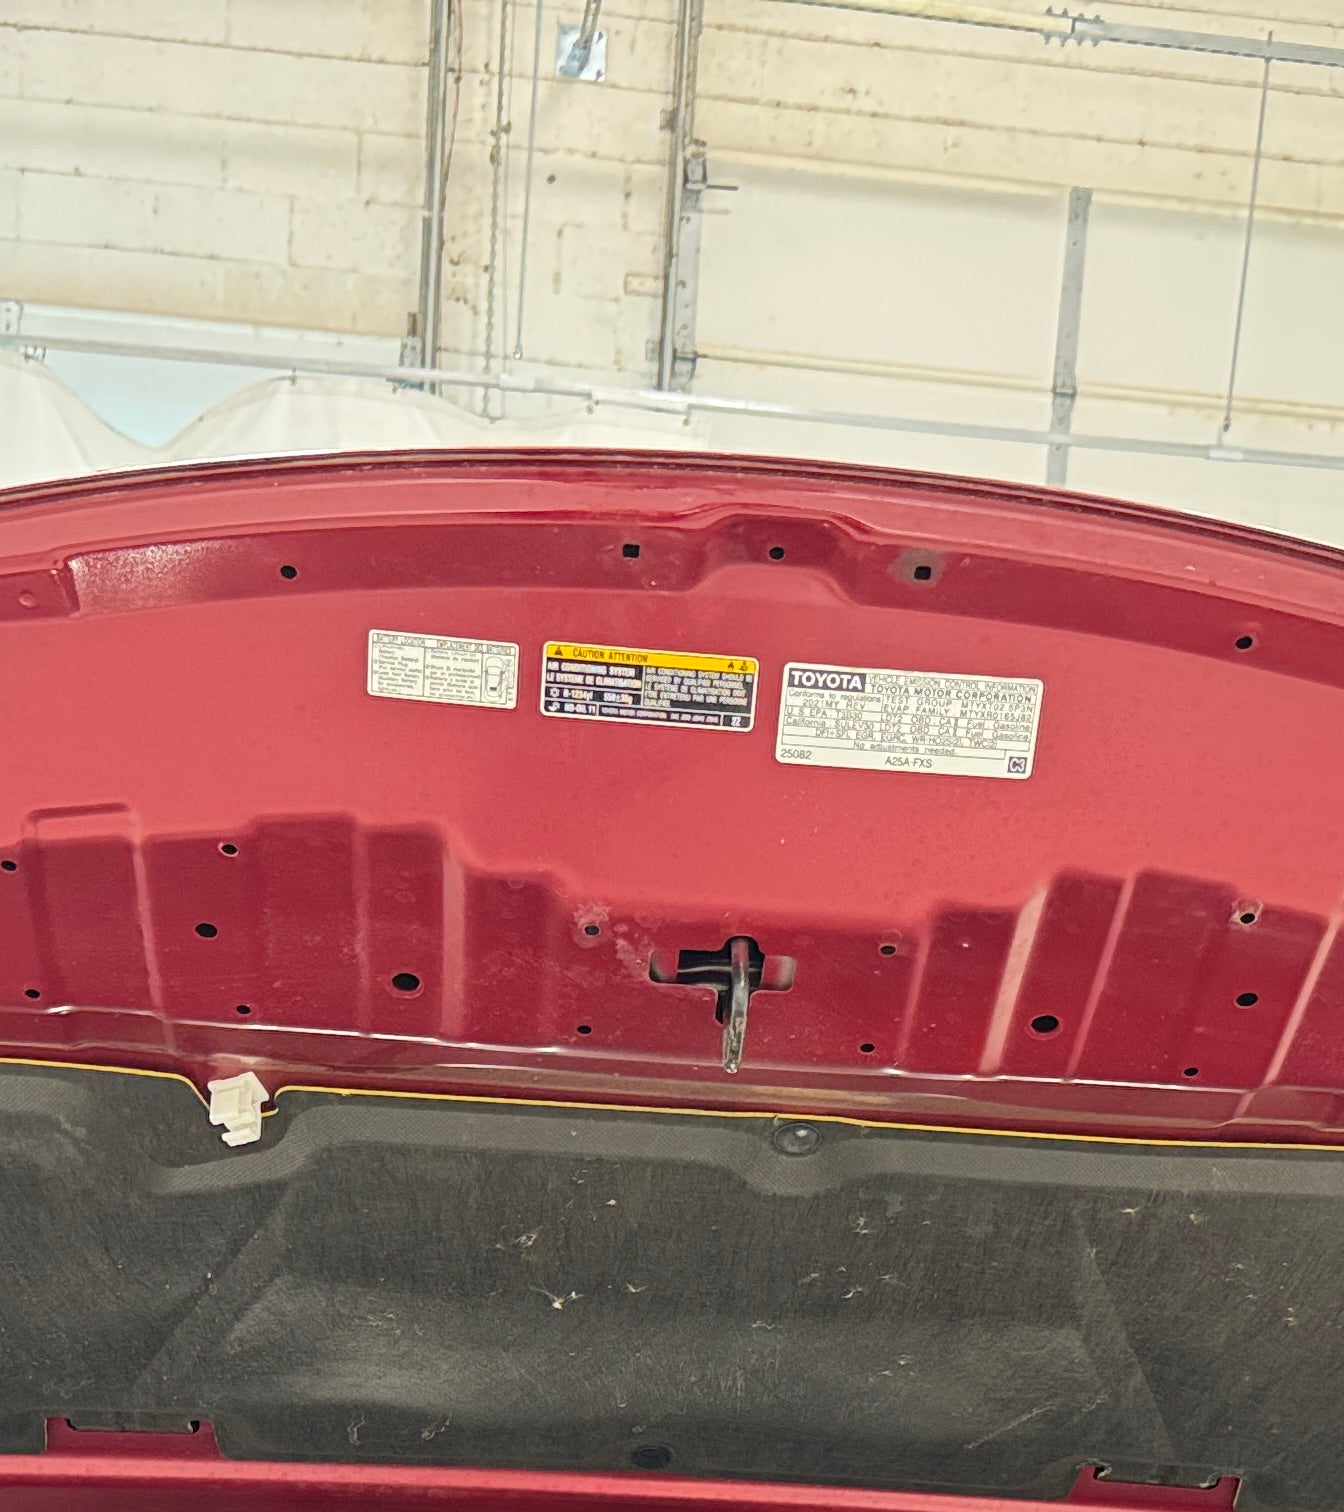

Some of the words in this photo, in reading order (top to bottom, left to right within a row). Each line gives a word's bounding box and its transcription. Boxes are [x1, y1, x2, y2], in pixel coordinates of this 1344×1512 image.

[572, 647, 604, 659] CAUTION
[608, 651, 648, 663] ATTENTION
[790, 670, 863, 690] TOYOTA
[944, 680, 977, 690] CONTROL
[870, 684, 910, 695] TOYOTA
[913, 687, 951, 698] MOTOR
[955, 690, 1031, 703] CORPORATION
[885, 695, 909, 704] TEST
[802, 698, 839, 709] 2021MY
[883, 704, 909, 713] EVAP
[915, 706, 950, 716] FAMILY
[853, 741, 865, 749] No
[780, 748, 812, 760] 25082
[884, 755, 933, 769] A25A-FXS
